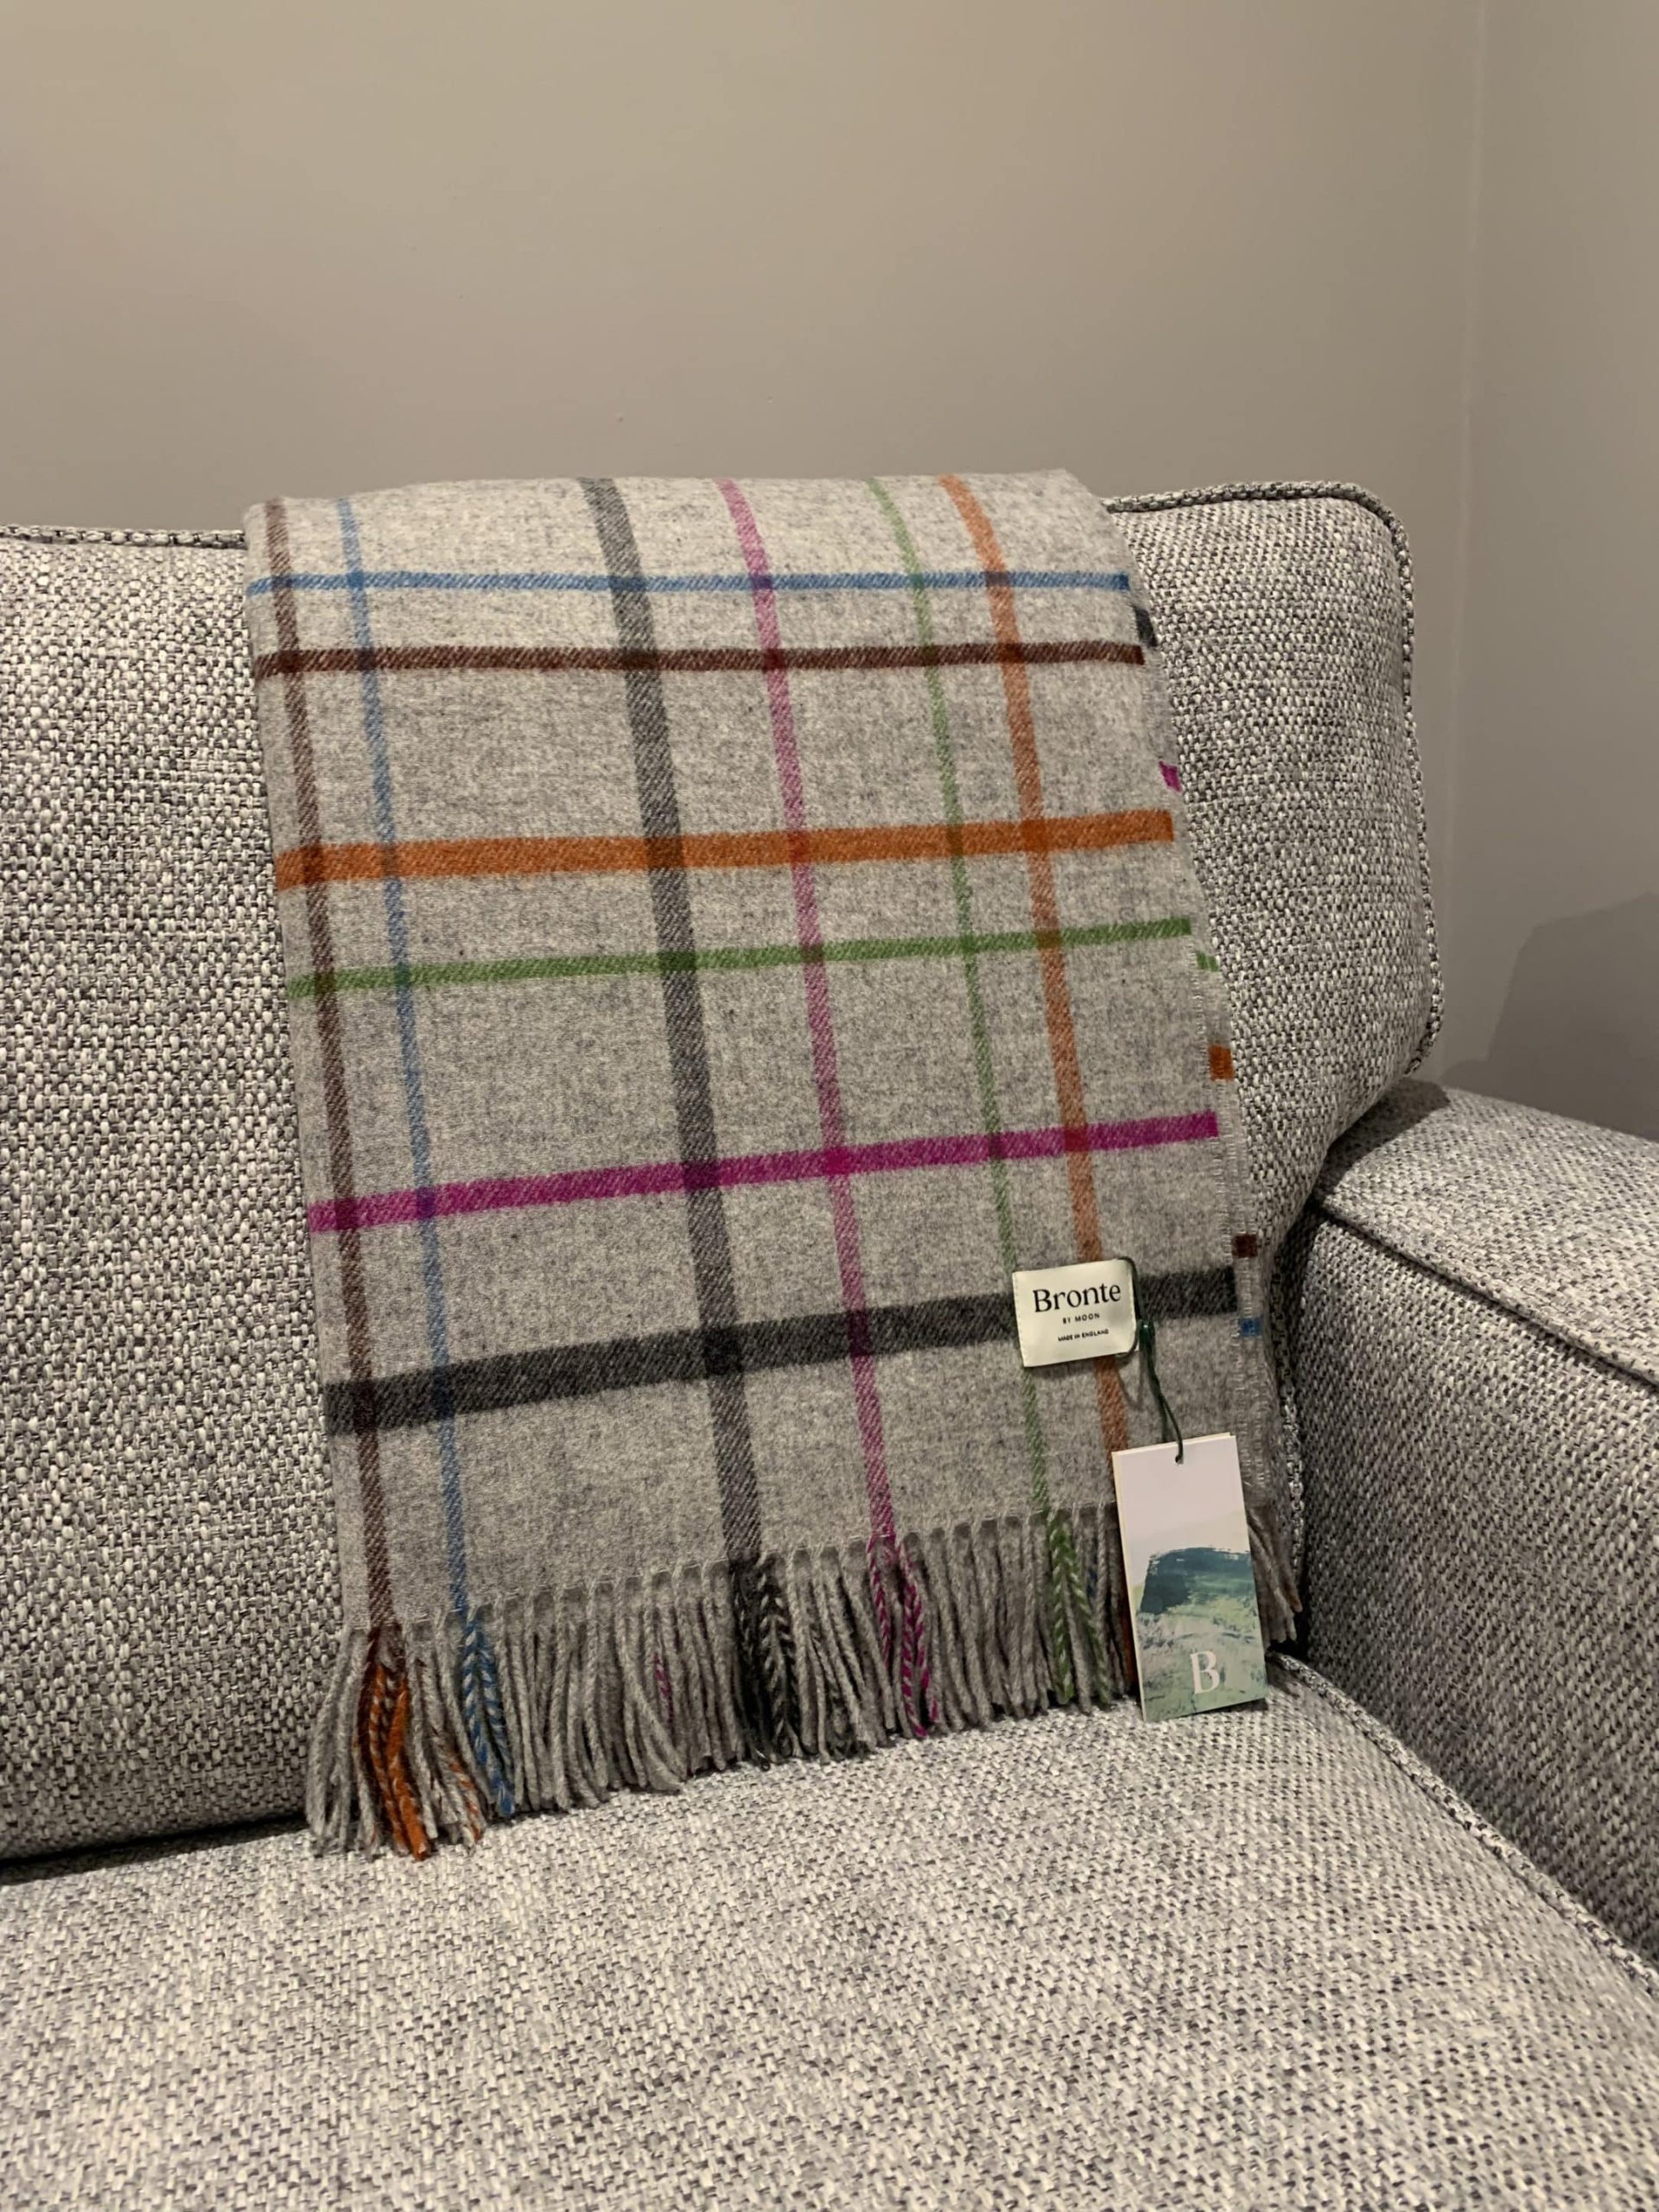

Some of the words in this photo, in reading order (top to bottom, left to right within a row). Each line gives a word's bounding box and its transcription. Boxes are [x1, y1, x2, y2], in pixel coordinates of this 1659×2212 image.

[1033, 1282, 1122, 1313] Bronte
[1075, 1313, 1100, 1322] MOON
[1082, 1328, 1109, 1338] ENGLAND
[1190, 1650, 1220, 1694] B
